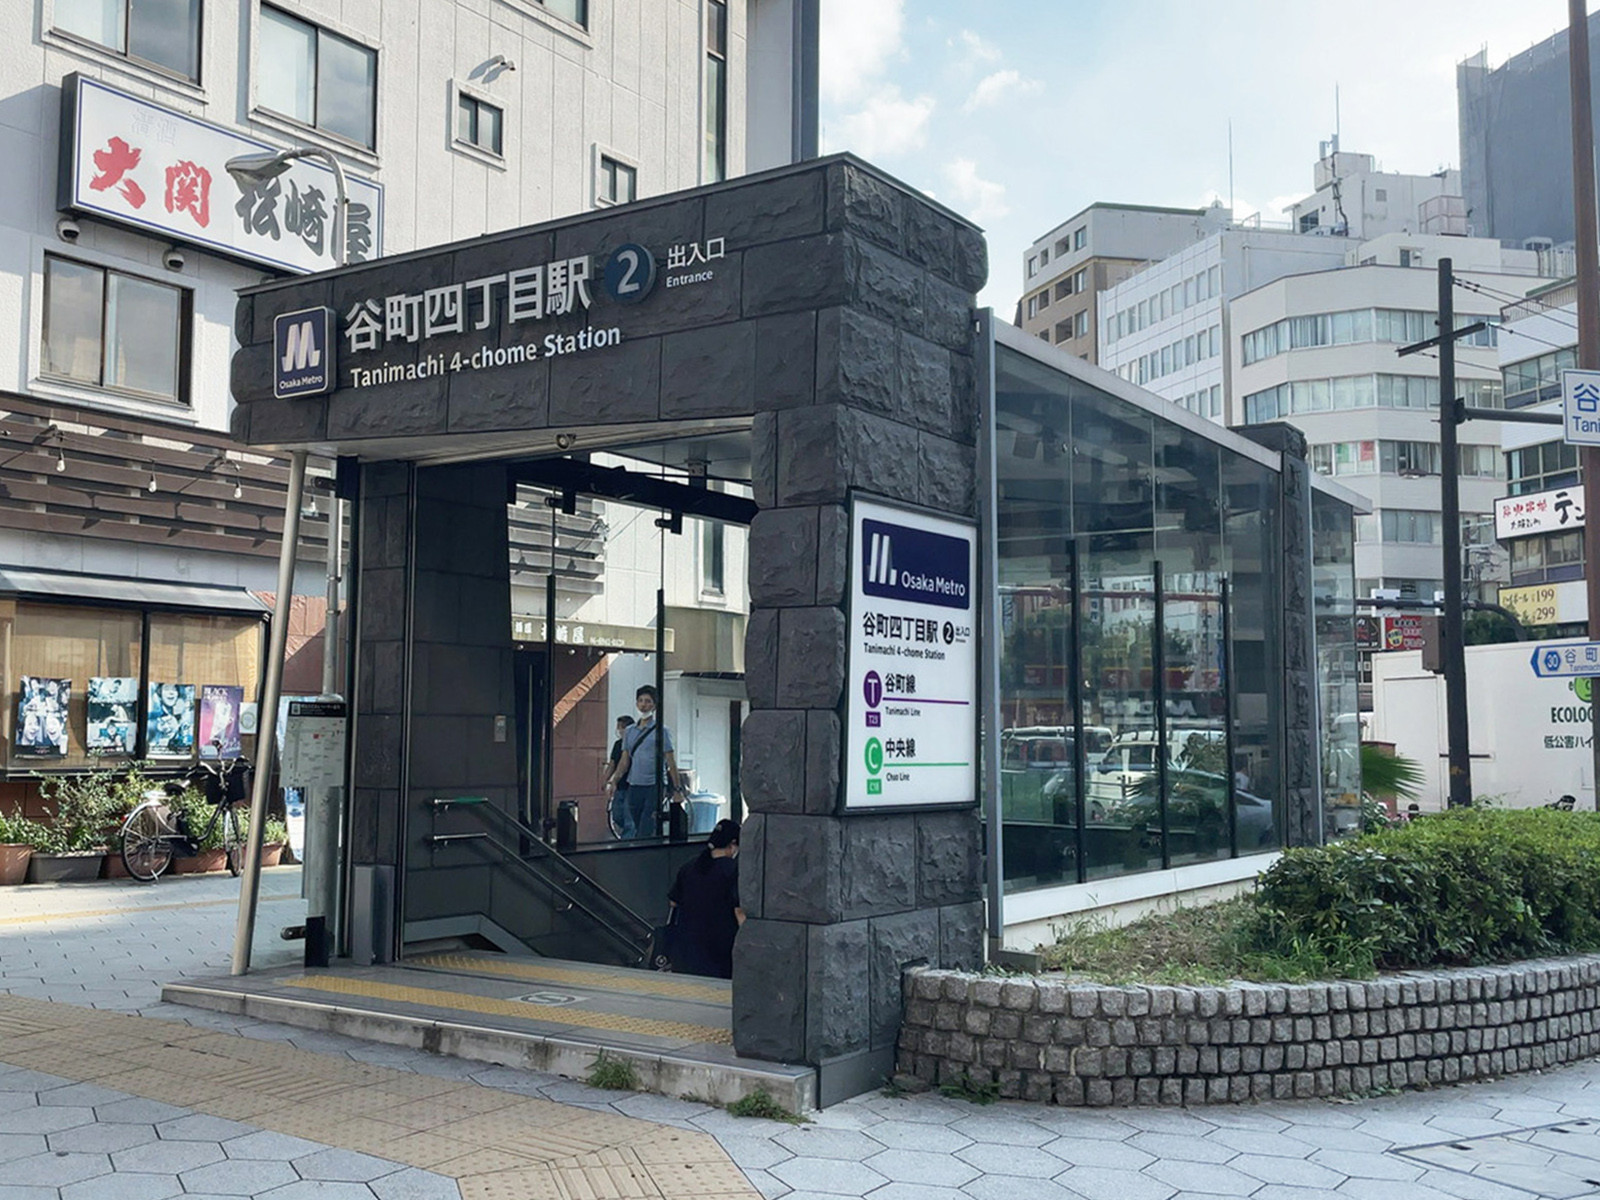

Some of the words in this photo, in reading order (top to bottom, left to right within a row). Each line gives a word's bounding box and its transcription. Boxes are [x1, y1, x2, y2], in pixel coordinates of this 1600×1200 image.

[667, 237, 725, 269] 出入口
[616, 249, 640, 295] 2
[666, 270, 714, 288] Entrance
[344, 255, 592, 353] 谷町四丁目駅
[351, 354, 445, 388] Tanimachi
[449, 343, 537, 373] 4-chome
[543, 325, 621, 358] Station
[279, 378, 301, 389] Osaka
[301, 375, 323, 386] Metro
[901, 571, 935, 592] Osaka
[935, 576, 966, 596] Metro
[1536, 606, 1556, 620] 299
[862, 611, 939, 643] 谷町四丁目駅
[864, 642, 896, 656] Tanimachi
[897, 646, 924, 659] 4-chome
[925, 648, 946, 660] Station
[867, 678, 878, 704] T
[885, 673, 917, 694] 谷町線
[885, 706, 910, 716] Tanimachi
[910, 707, 921, 717] Line
[868, 743, 879, 769] C
[885, 738, 917, 758] 中央線
[886, 772, 899, 781] Chuo
[899, 772, 911, 781] Line
